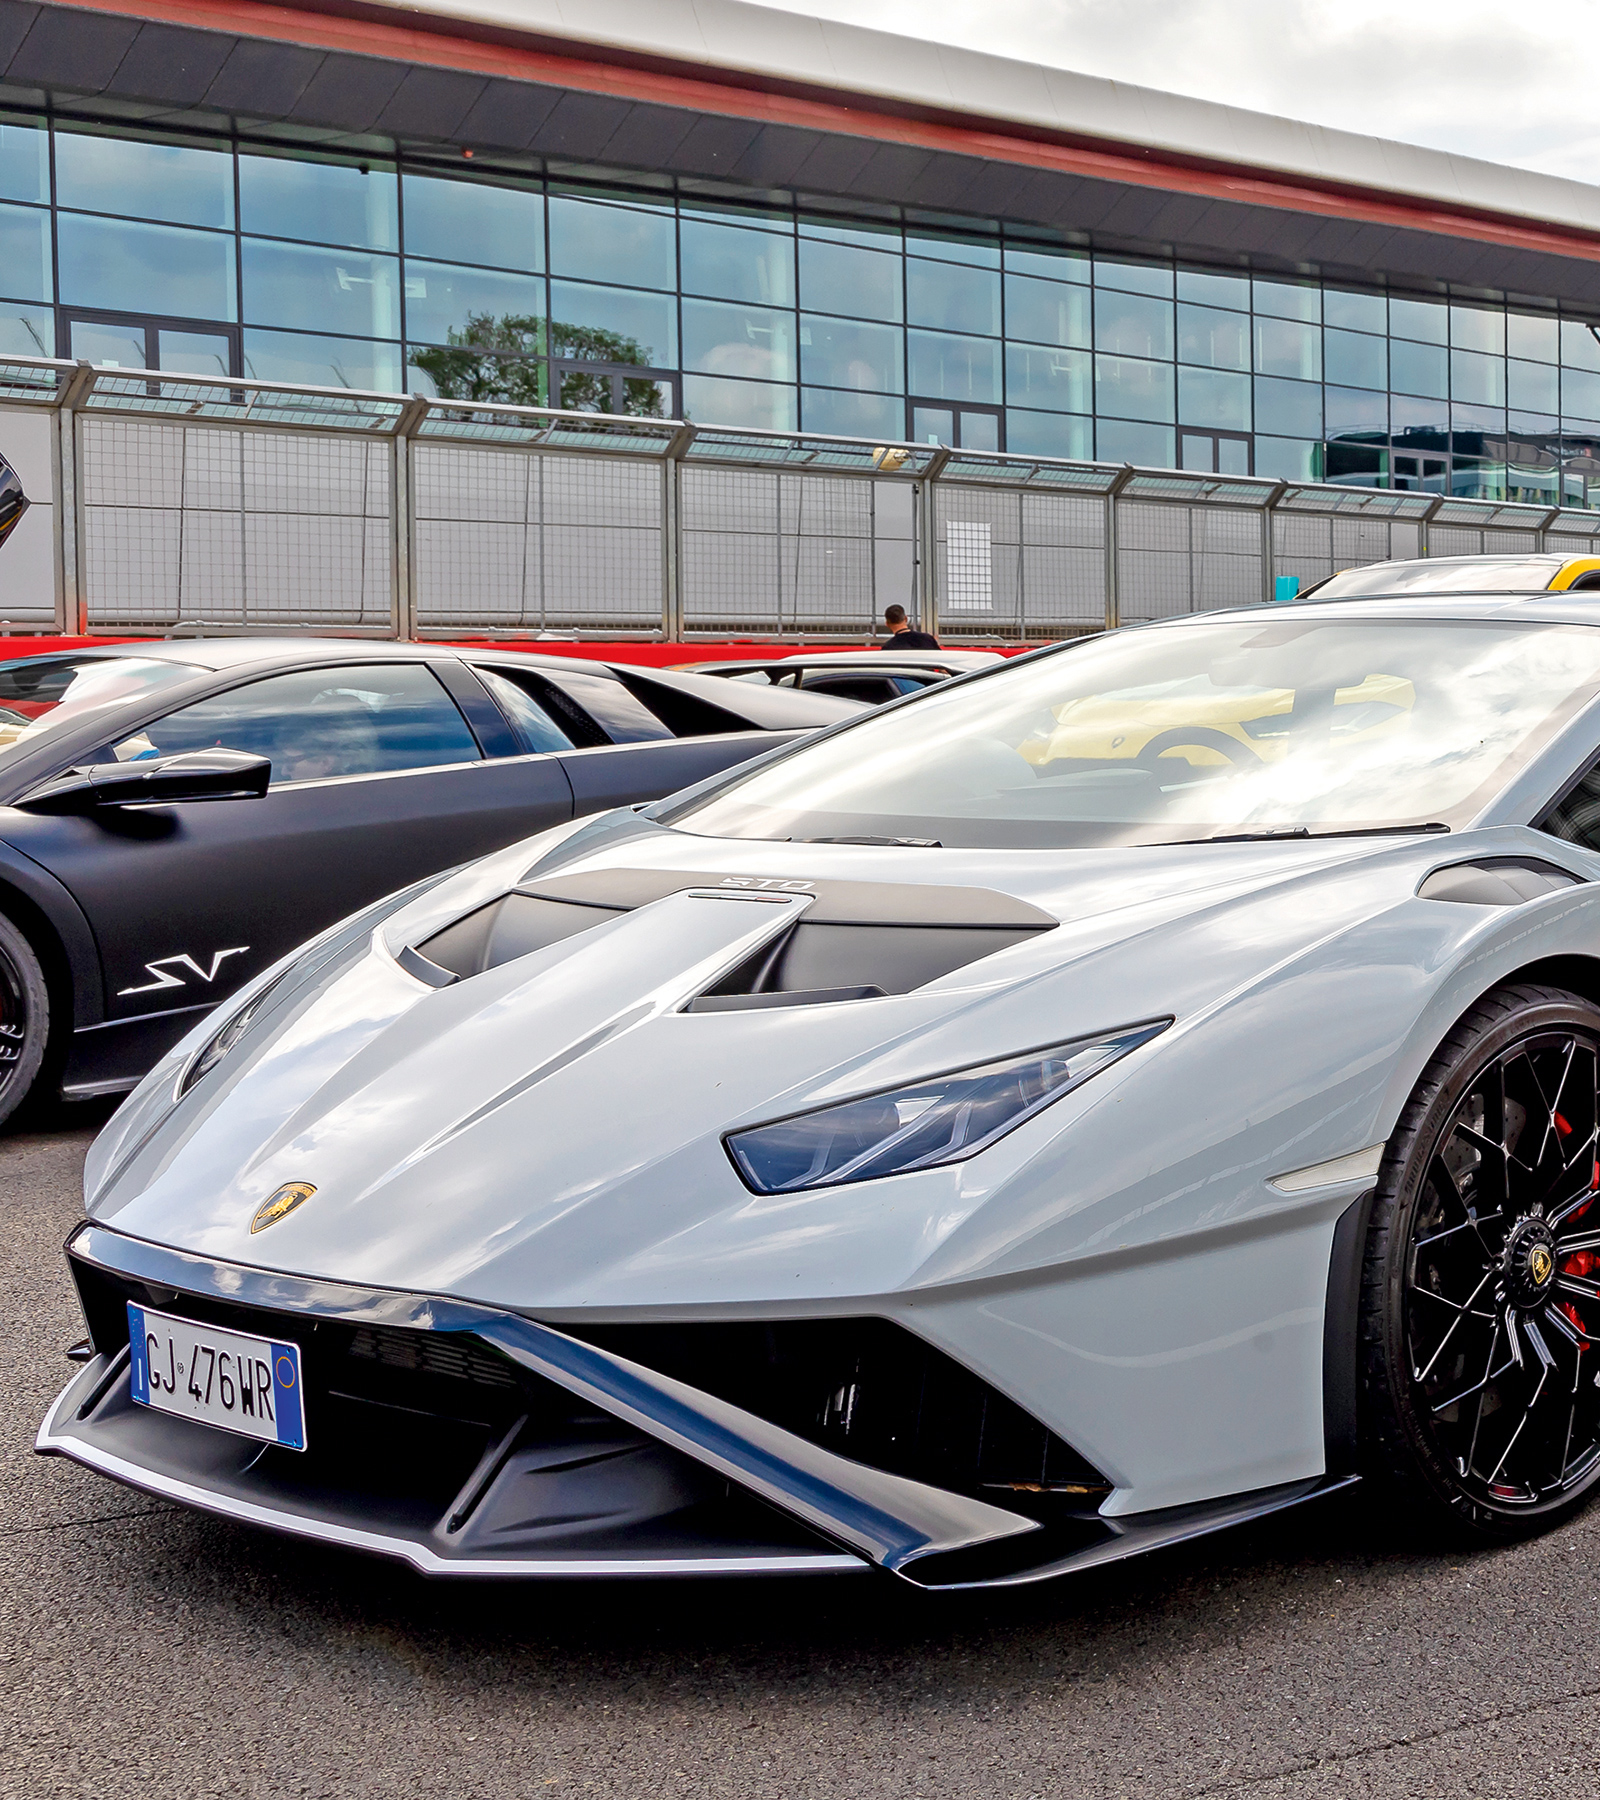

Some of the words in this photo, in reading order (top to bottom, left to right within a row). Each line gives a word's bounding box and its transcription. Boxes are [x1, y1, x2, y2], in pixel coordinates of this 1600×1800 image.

[719, 877, 816, 889] STO
[117, 946, 250, 996] SV
[146, 1331, 176, 1395] GJ
[188, 1343, 275, 1422] 476WR
